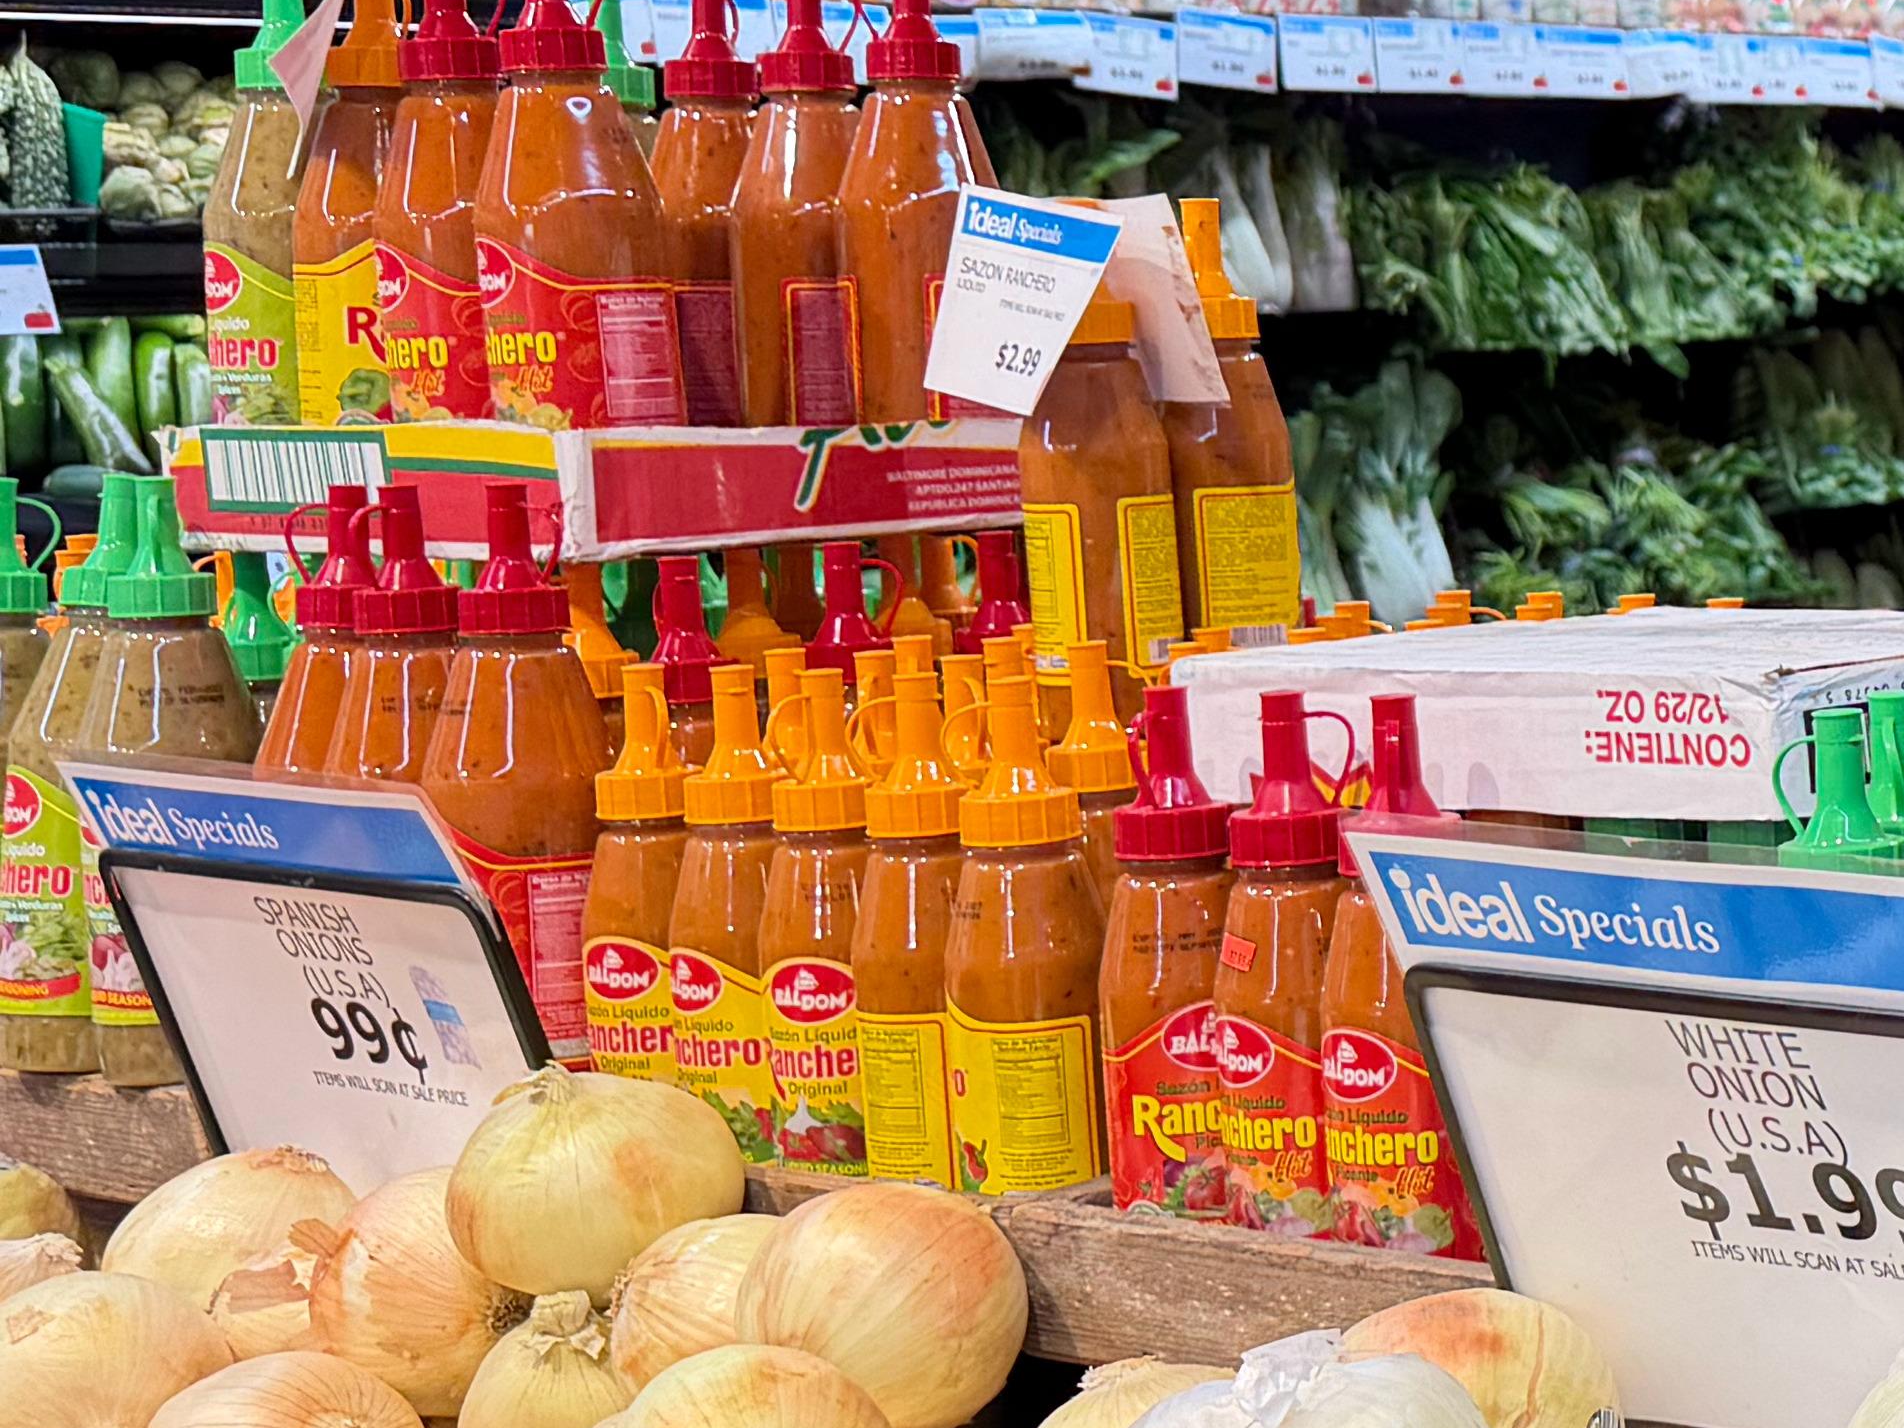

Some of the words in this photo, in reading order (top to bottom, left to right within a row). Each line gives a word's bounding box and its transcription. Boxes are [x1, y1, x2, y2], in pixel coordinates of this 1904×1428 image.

[969, 201, 1018, 240] ideal
[1016, 218, 1063, 245] Specials
[960, 256, 1002, 282] SAZON
[1004, 266, 1056, 294] RANCHERO
[995, 341, 1042, 377] $2.99
[1593, 688, 1646, 724] OZ.
[1653, 691, 1730, 725] 12/29
[1584, 730, 1752, 769] CONTIENE:
[85, 786, 178, 846] ideal
[167, 807, 280, 852] Specials
[253, 895, 362, 935] SPANISH
[1388, 862, 1536, 944] ideal
[1533, 894, 1721, 954] Specials
[275, 928, 374, 966] ONIONS
[302, 964, 391, 1008] (U.S.A)
[588, 964, 651, 990] BALDOM
[774, 987, 849, 1011] BALDOM
[310, 996, 429, 1085] 99¢
[1665, 1019, 1811, 1070] WHITE
[599, 1054, 652, 1072] Original
[313, 1069, 346, 1088] ITEMS
[345, 1073, 373, 1093] WILL
[371, 1076, 397, 1097] SCAN
[412, 1083, 436, 1104] SALE
[436, 1086, 469, 1107] PRICE
[787, 1079, 849, 1098] Original
[1685, 1062, 1828, 1112] ONION
[1707, 1107, 1849, 1169] (U.S.A)
[1691, 1239, 1746, 1263] ITEMS
[1745, 1244, 1793, 1269] WILL
[1793, 1249, 1842, 1274] SCAN
[1844, 1257, 1867, 1277] AT
